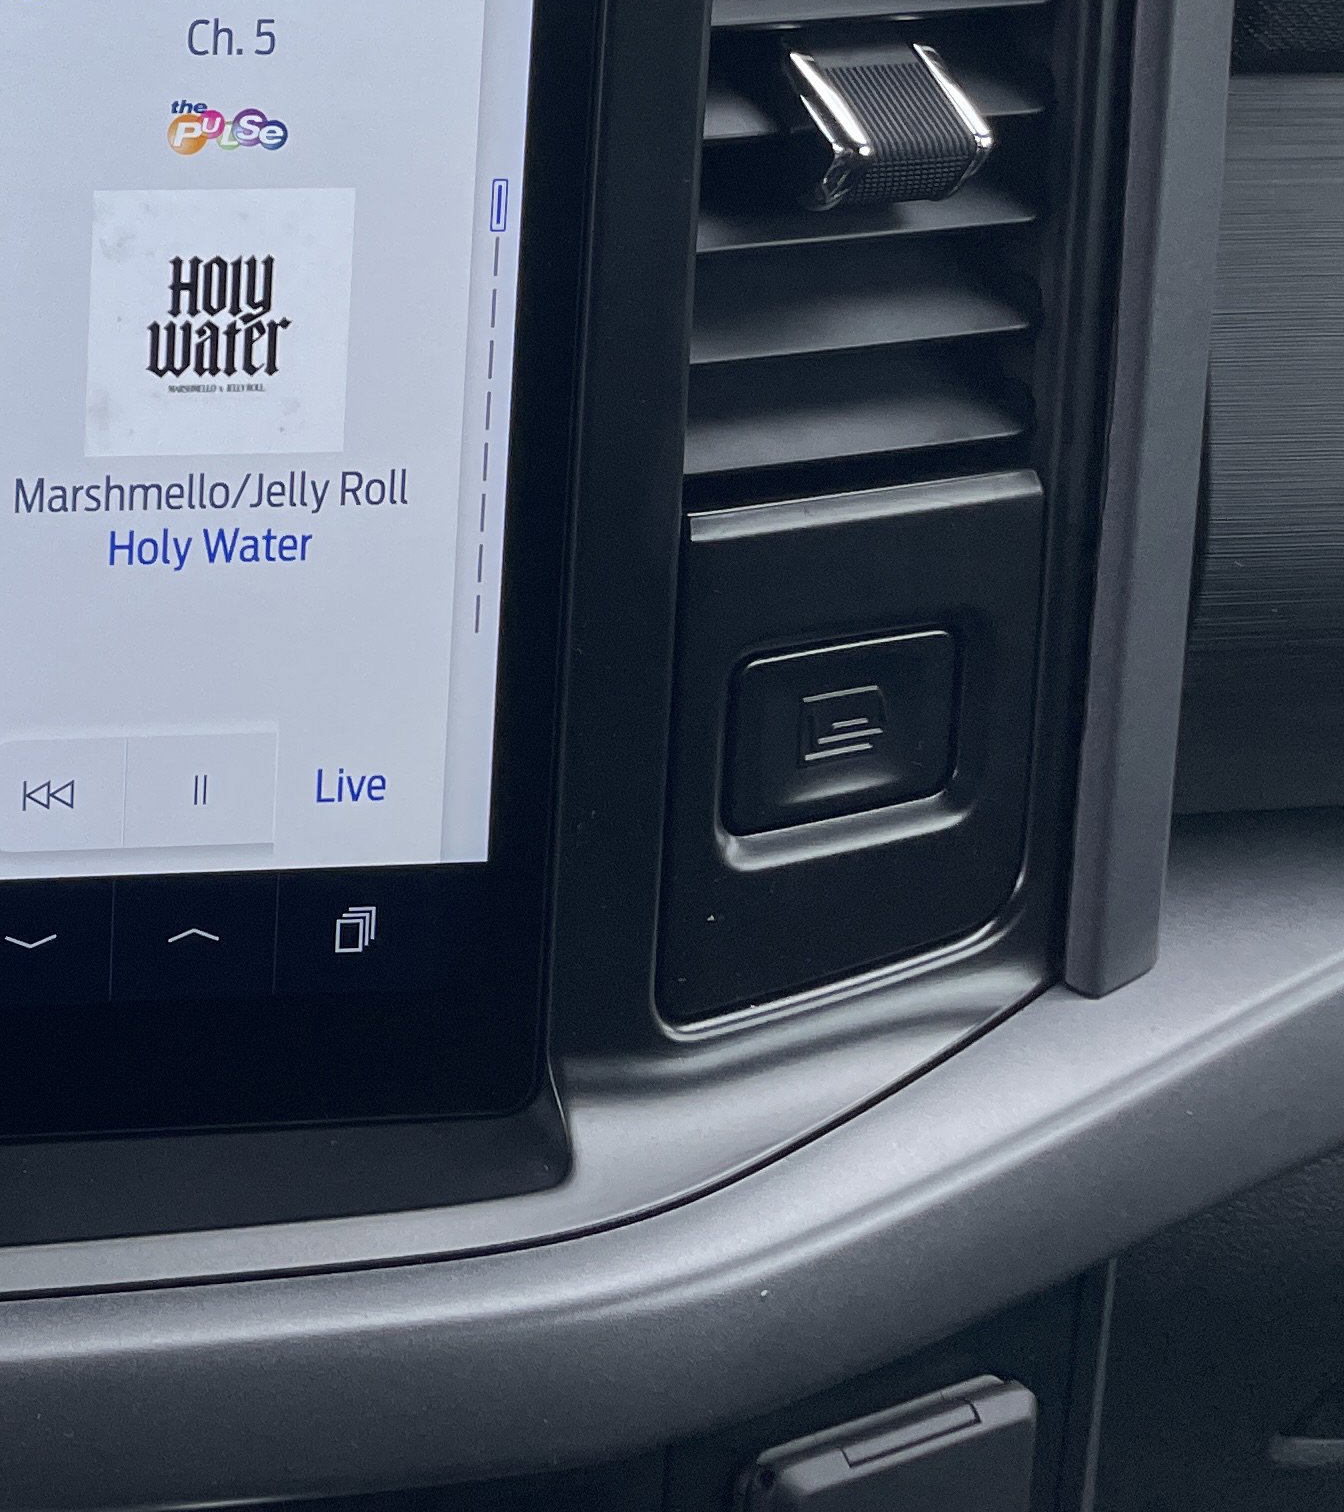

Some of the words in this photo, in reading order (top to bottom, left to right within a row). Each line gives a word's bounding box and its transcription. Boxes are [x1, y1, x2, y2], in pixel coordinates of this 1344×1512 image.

[187, 17, 244, 56] Ch.
[254, 18, 276, 56] 5
[171, 99, 208, 113] the
[14, 470, 330, 514] Marshmello/Jelly
[340, 468, 408, 506] Roll
[109, 527, 193, 572] Holy
[202, 527, 313, 564] Water
[316, 767, 386, 803] Live
